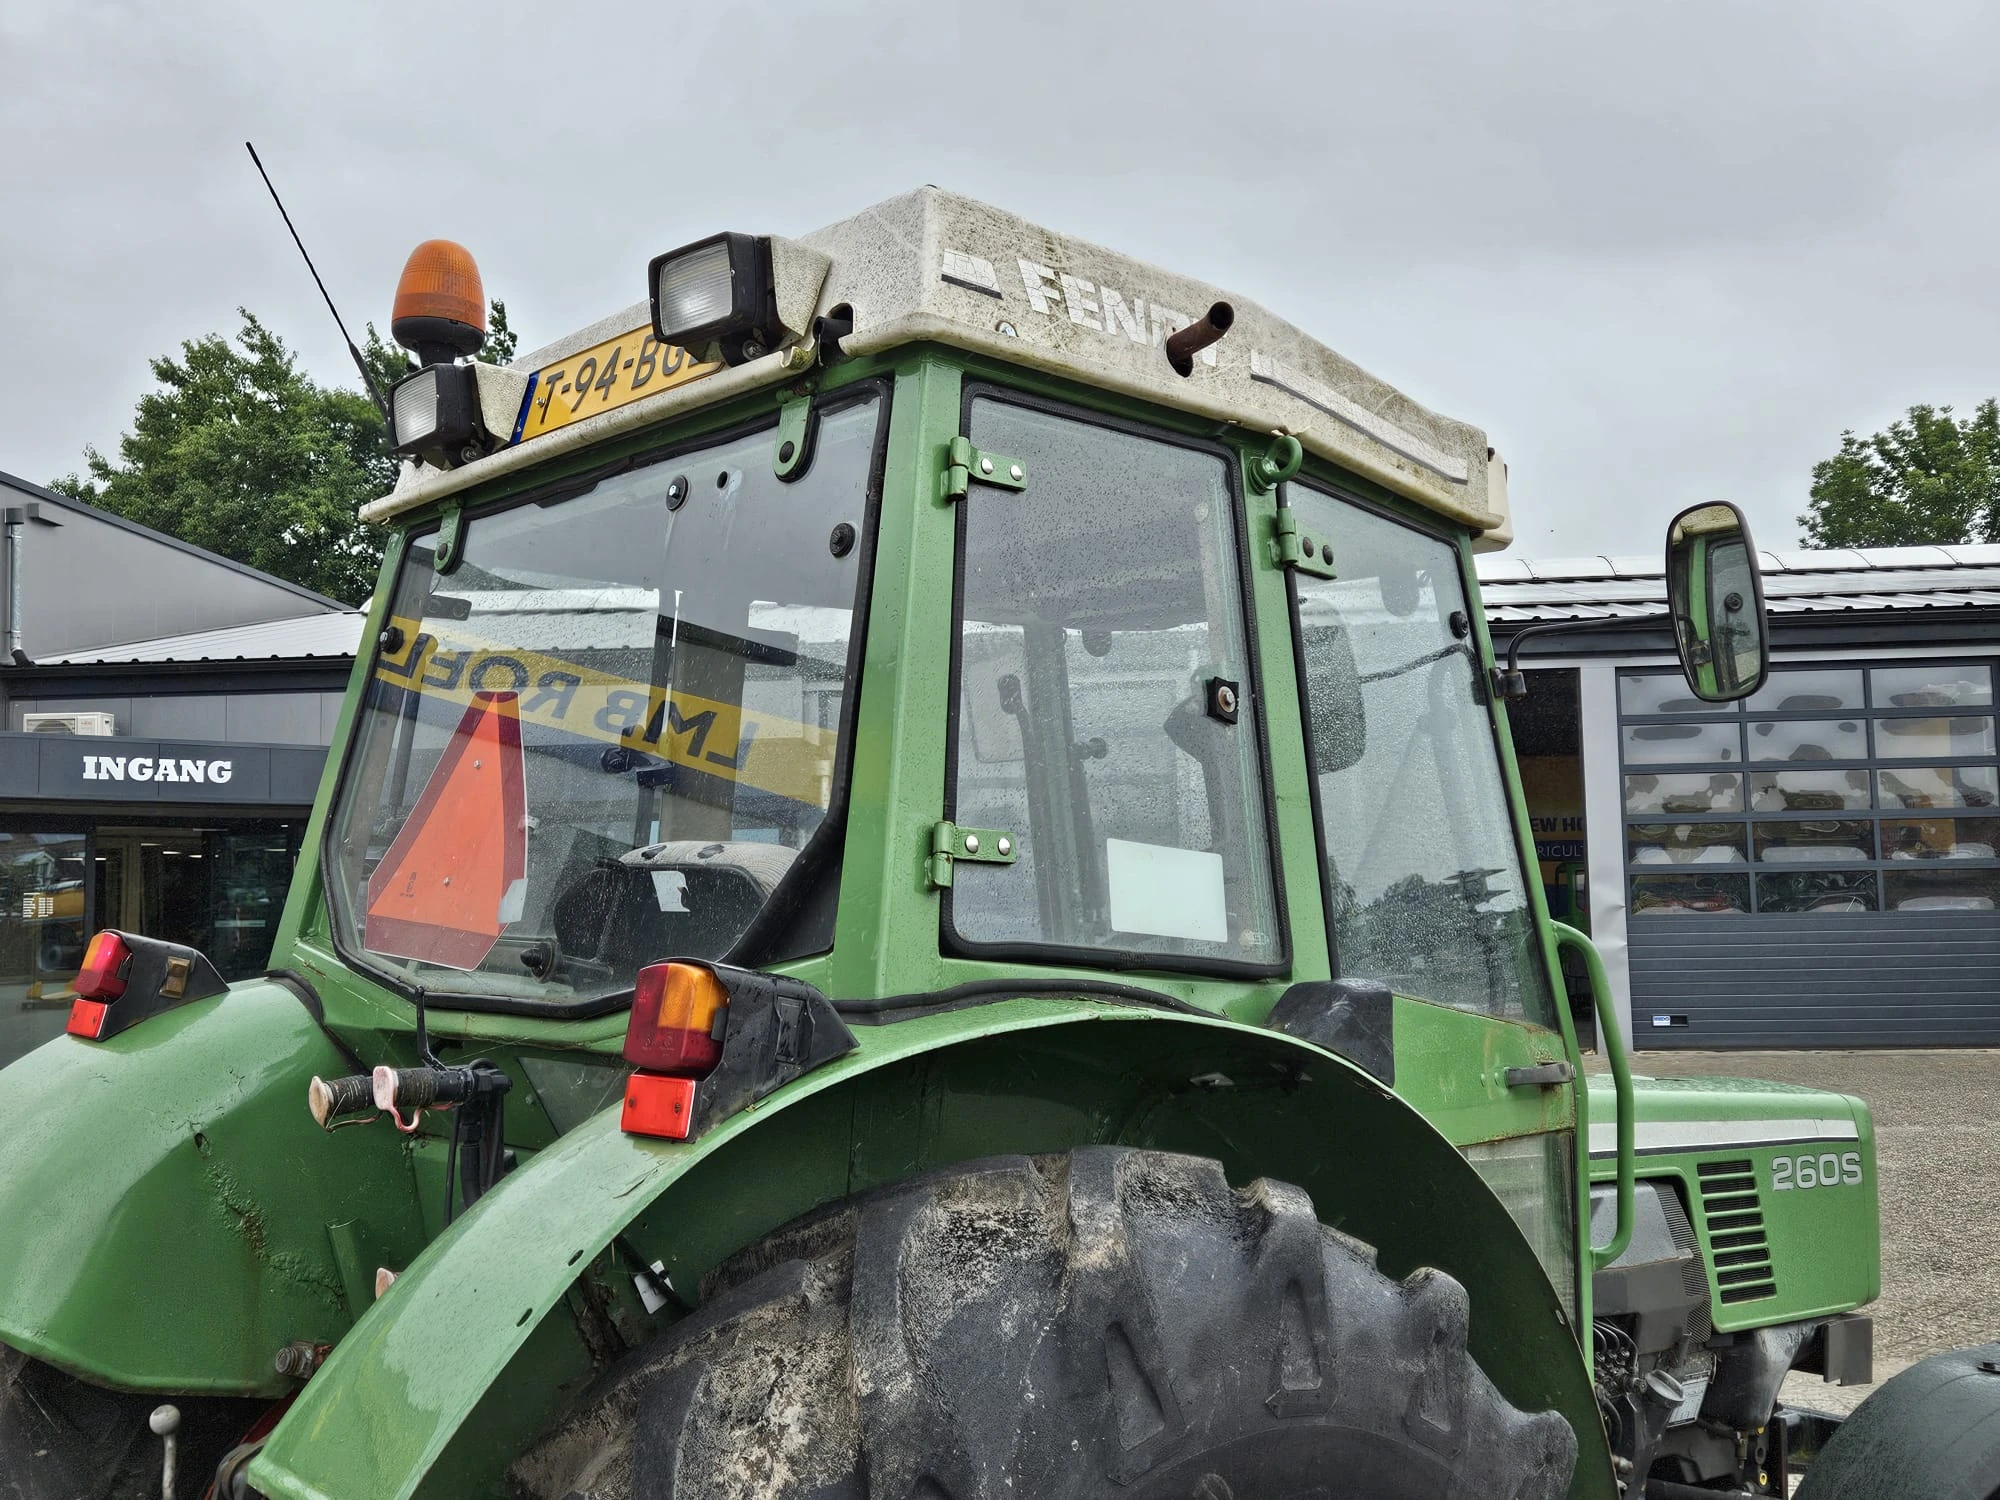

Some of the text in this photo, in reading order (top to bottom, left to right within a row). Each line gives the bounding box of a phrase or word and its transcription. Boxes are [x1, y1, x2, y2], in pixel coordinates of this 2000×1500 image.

[539, 334, 701, 424] T-94-BG
[83, 756, 232, 783] INGANG
[1772, 1151, 1863, 1191] 260S
